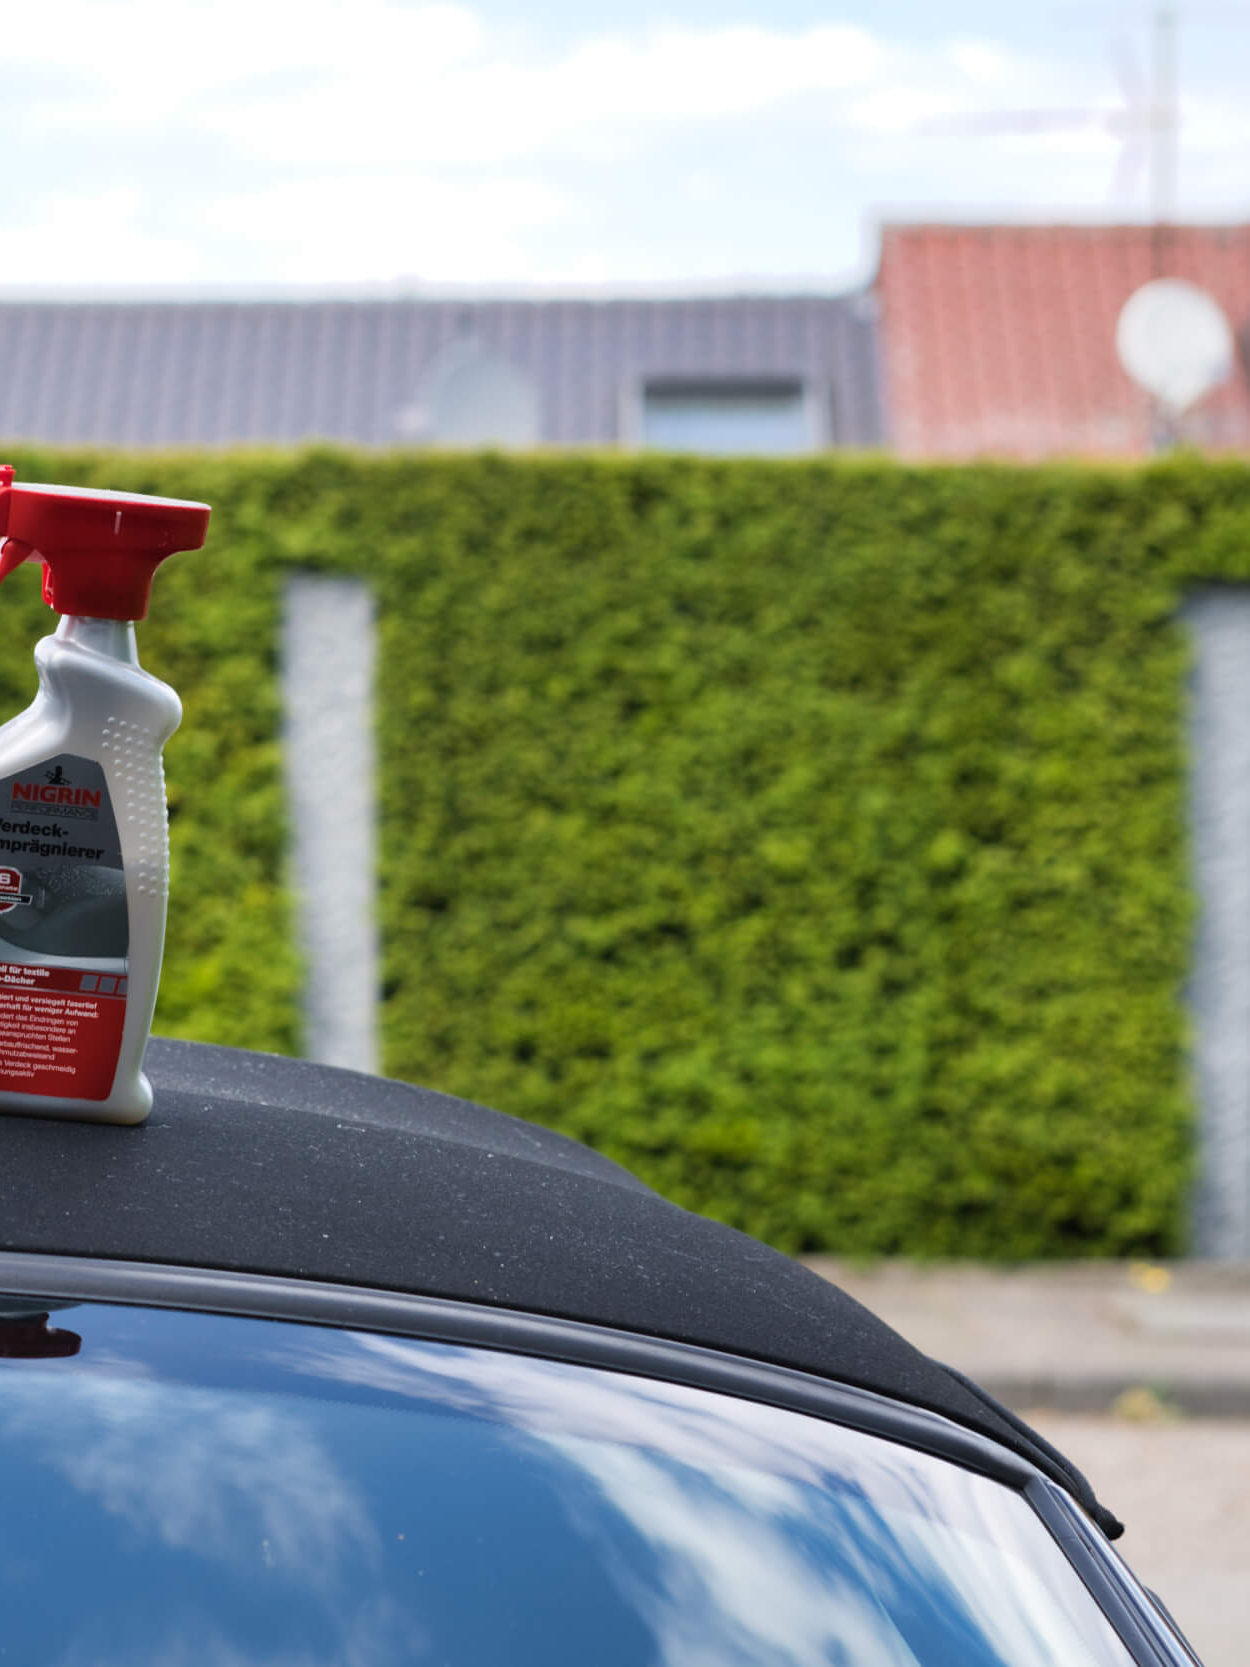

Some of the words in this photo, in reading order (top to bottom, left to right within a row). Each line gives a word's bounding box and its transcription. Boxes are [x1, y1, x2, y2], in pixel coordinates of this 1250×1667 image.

[12, 781, 102, 808] NIGRIN
[9, 966, 22, 974] für
[23, 967, 50, 977] textile
